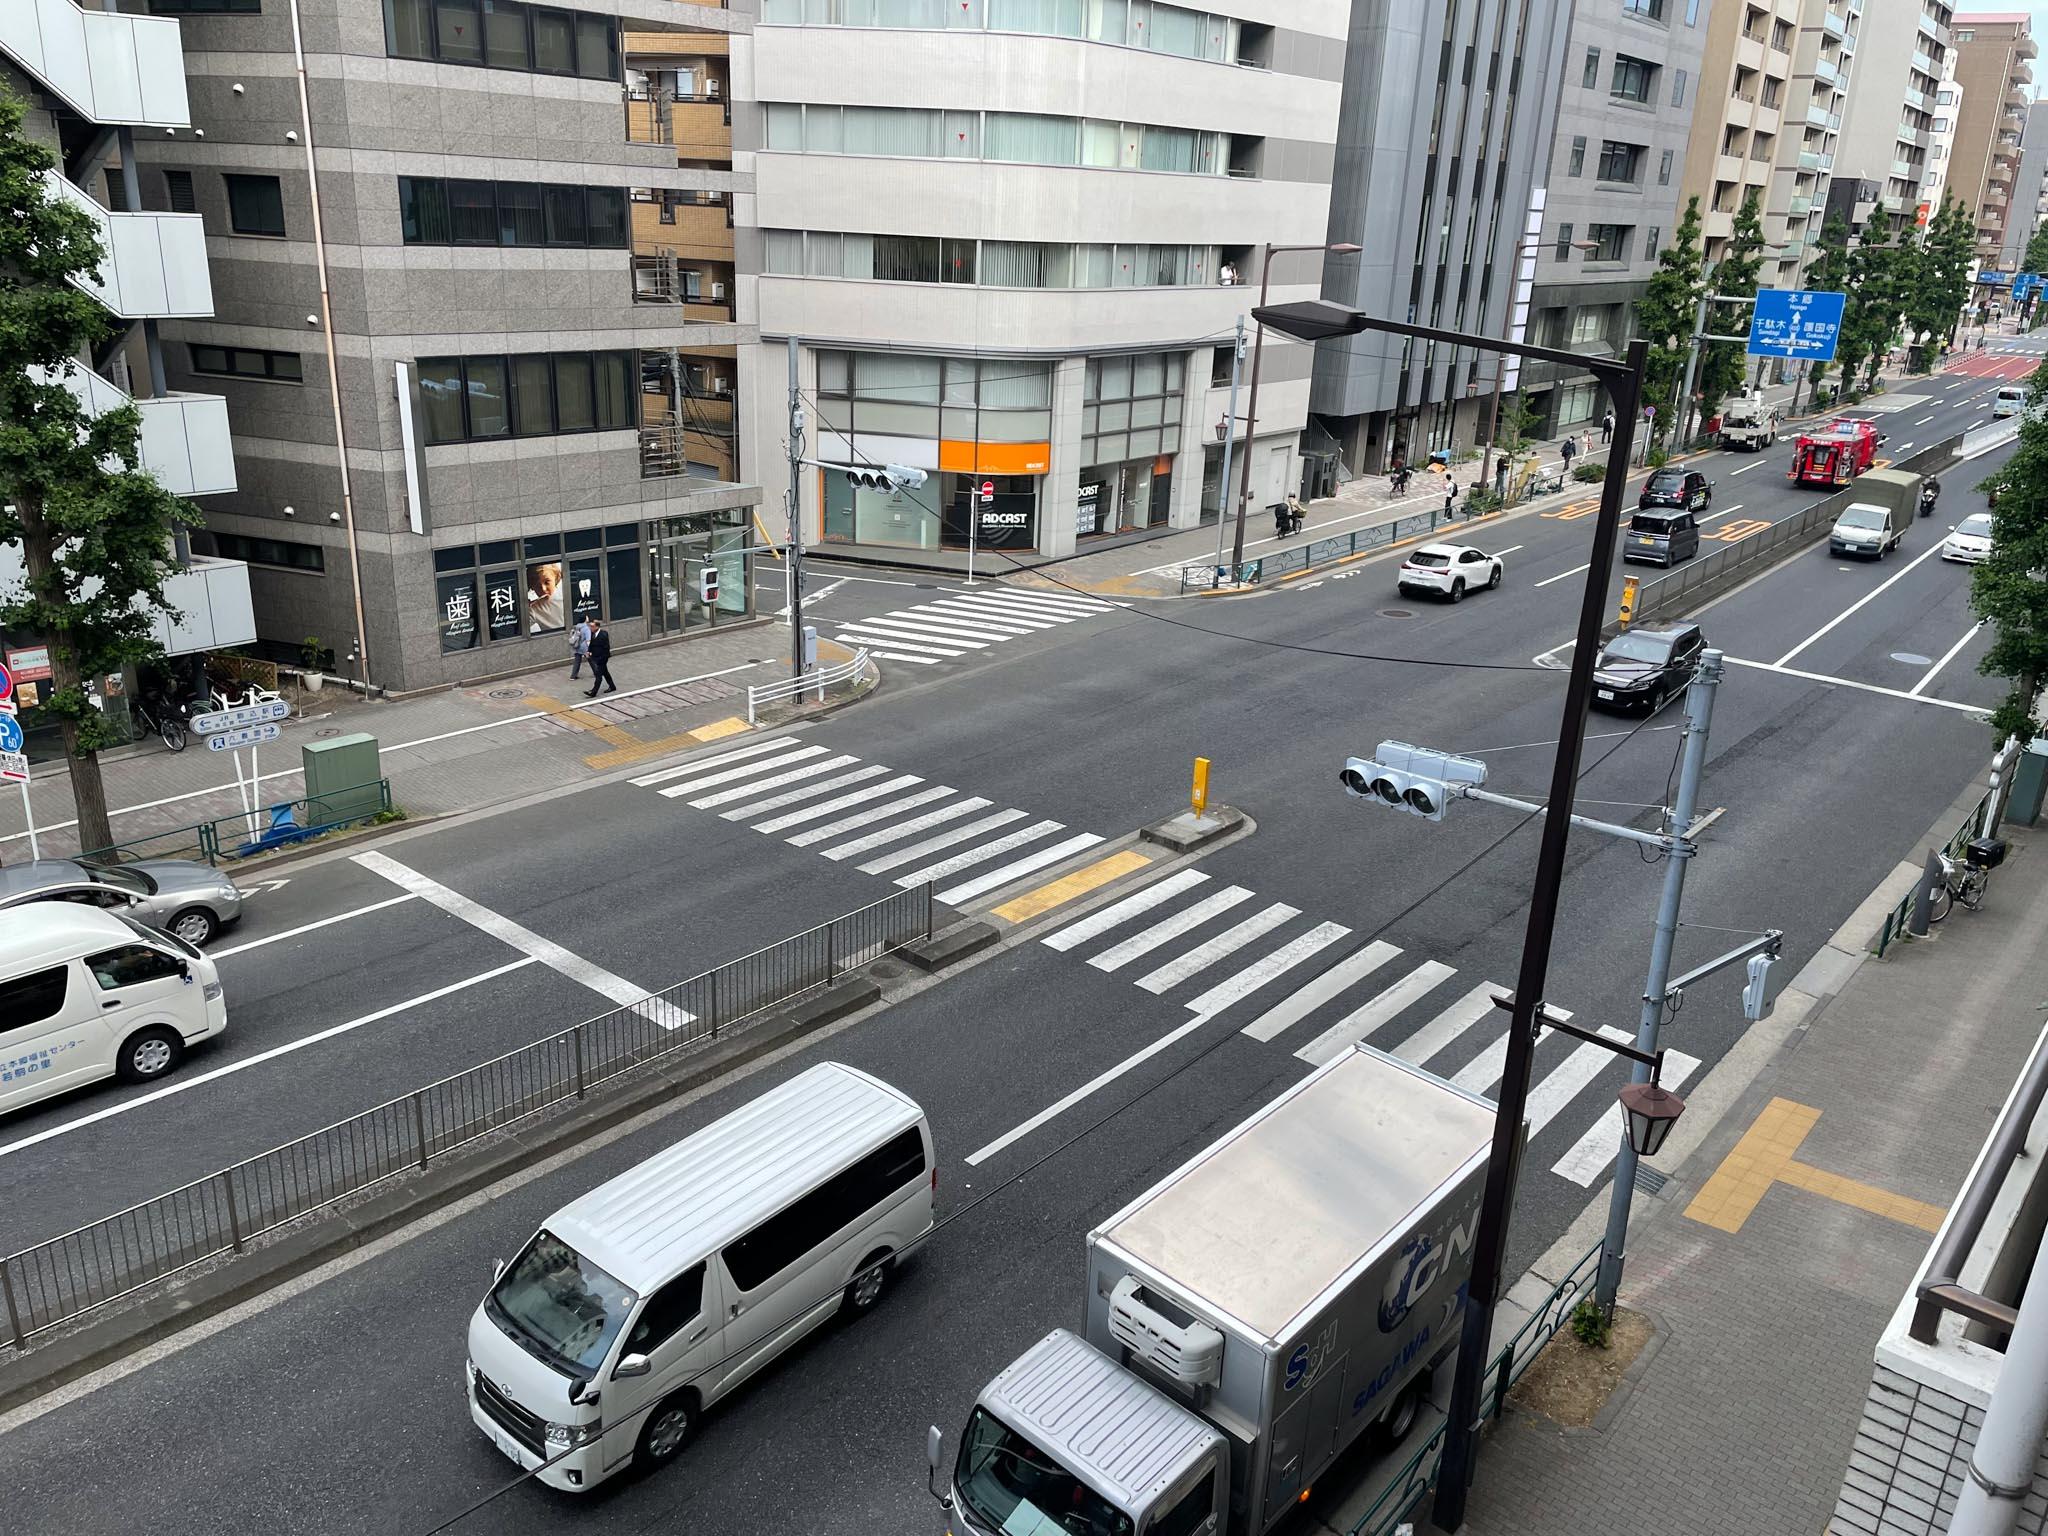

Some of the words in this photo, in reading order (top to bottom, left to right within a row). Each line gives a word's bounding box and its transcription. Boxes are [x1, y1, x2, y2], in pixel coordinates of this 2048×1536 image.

[1077, 485, 1099, 497] DCAST
[982, 513, 1028, 523] ADCAST
[1406, 1206, 1481, 1308] CN
[1351, 1326, 1430, 1417] SAGAWA
